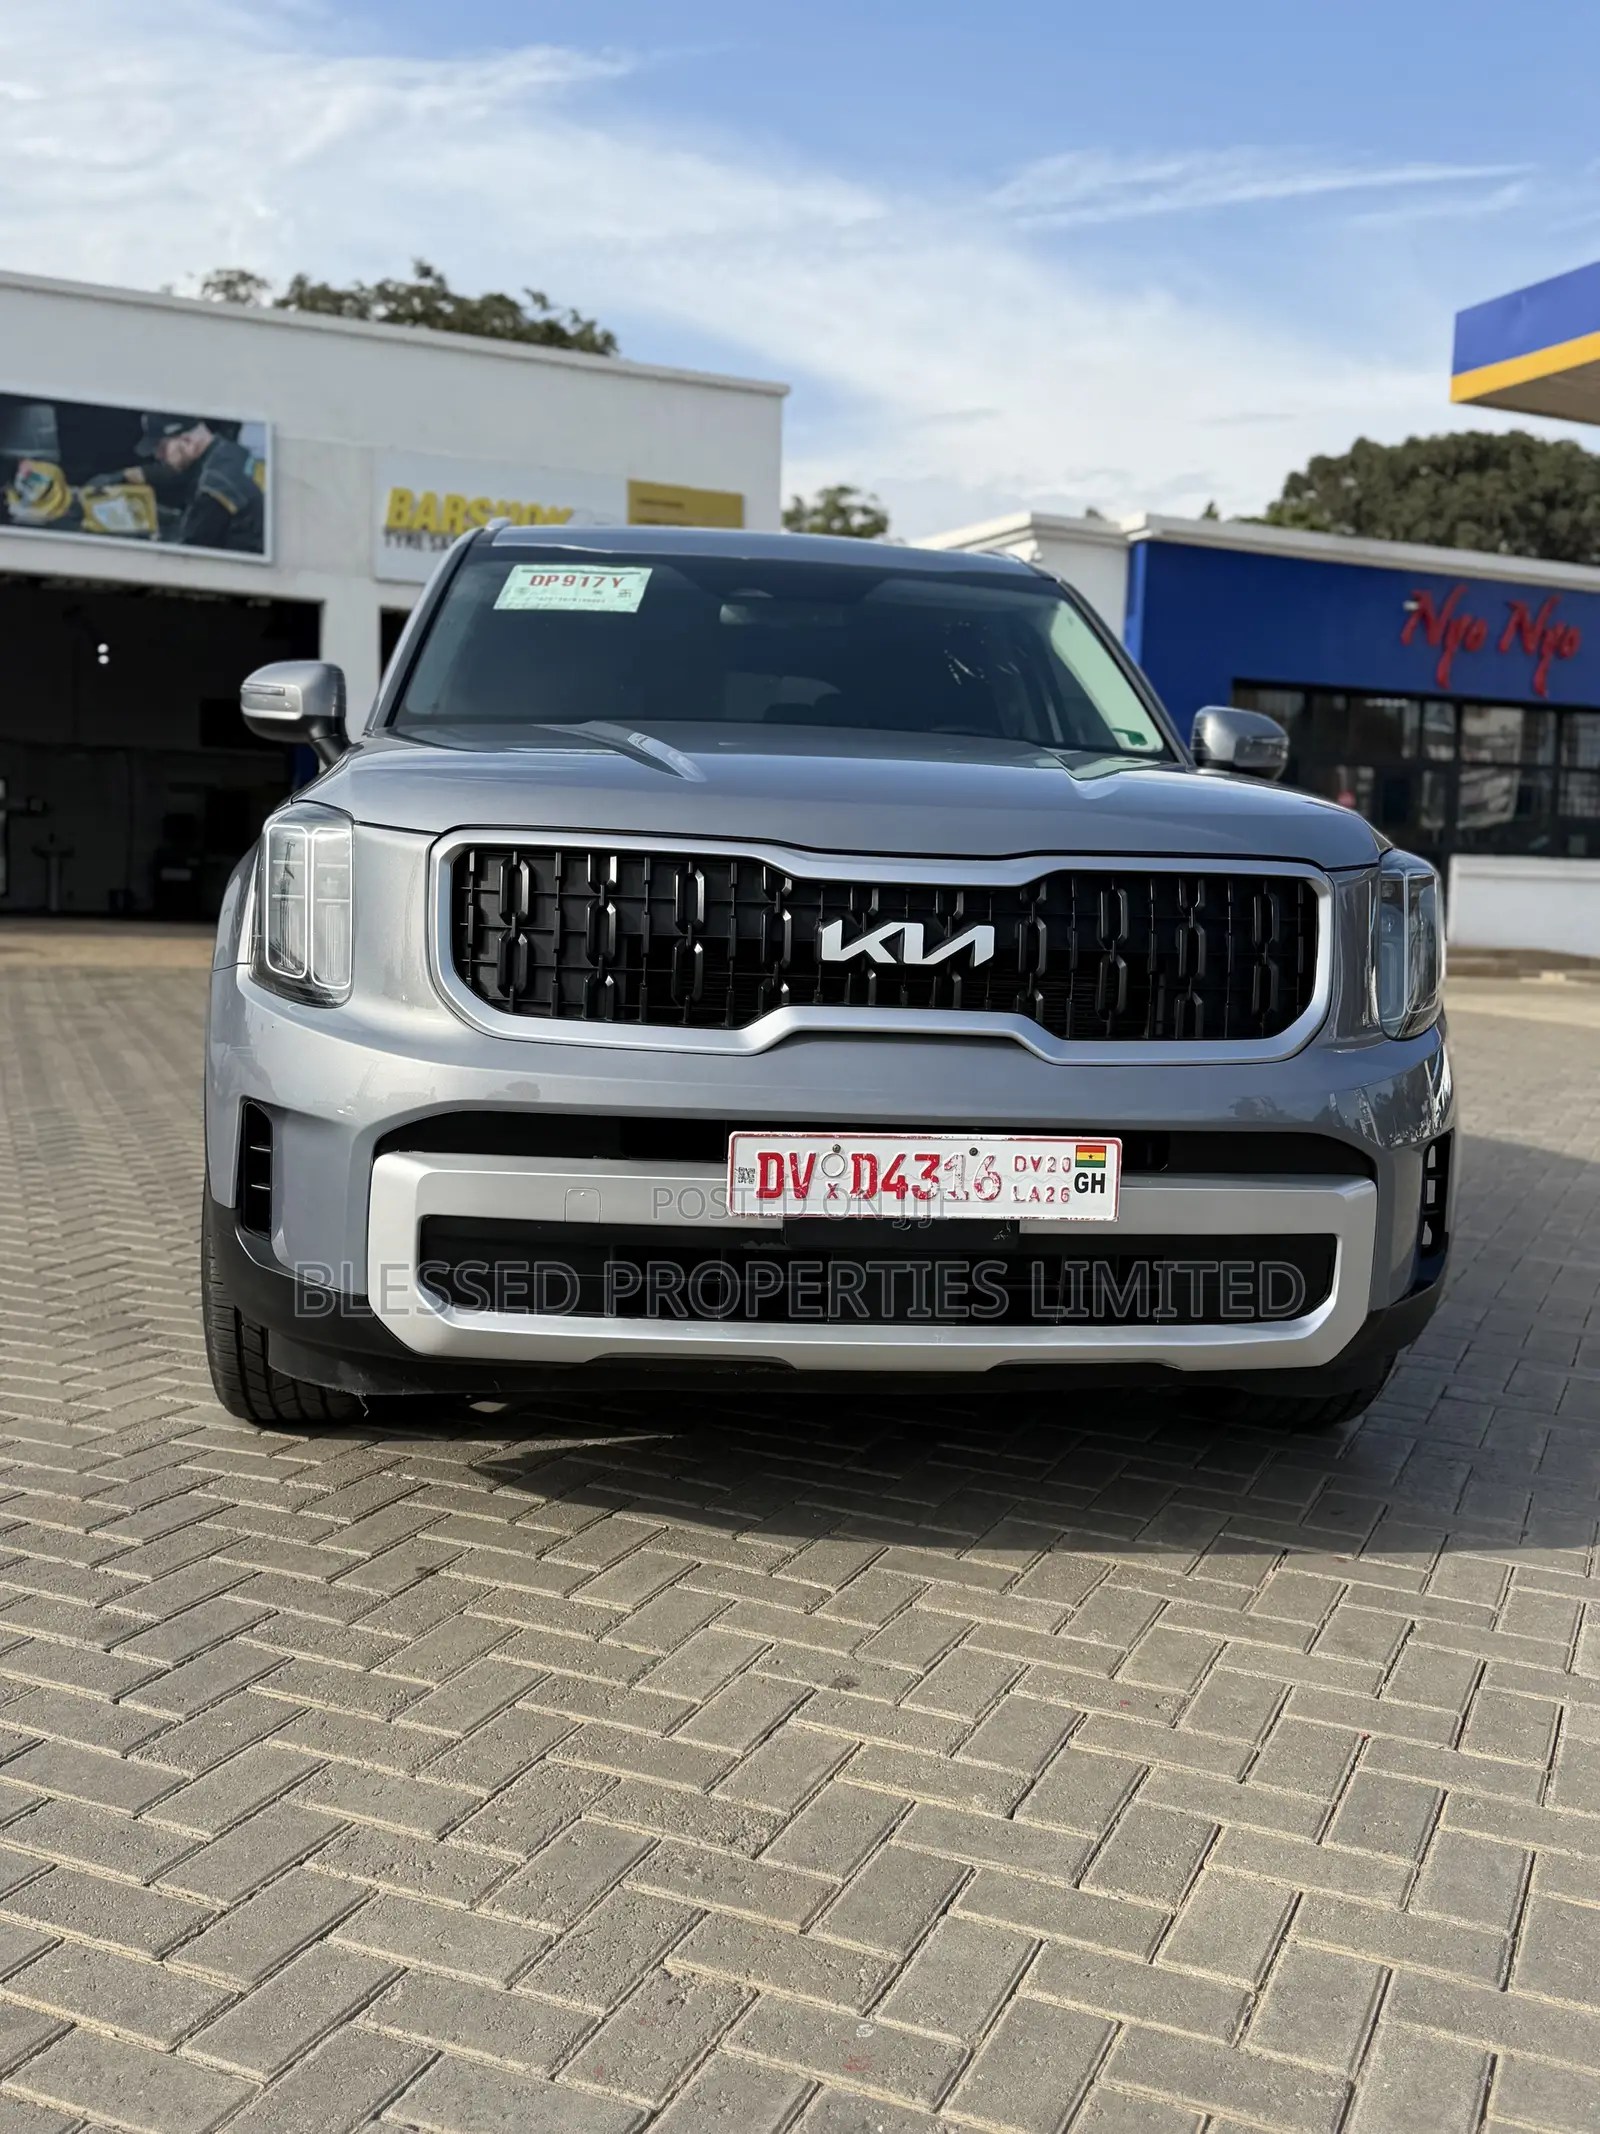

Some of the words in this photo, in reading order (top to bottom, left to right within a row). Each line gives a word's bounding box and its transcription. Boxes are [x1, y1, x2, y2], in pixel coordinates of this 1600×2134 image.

[561, 574, 605, 588] 917
[612, 576, 625, 588] Y
[822, 919, 995, 967] KIA
[756, 1151, 816, 1199] DV
[850, 1153, 1001, 1201] D4316
[1074, 1172, 1105, 1194] GH
